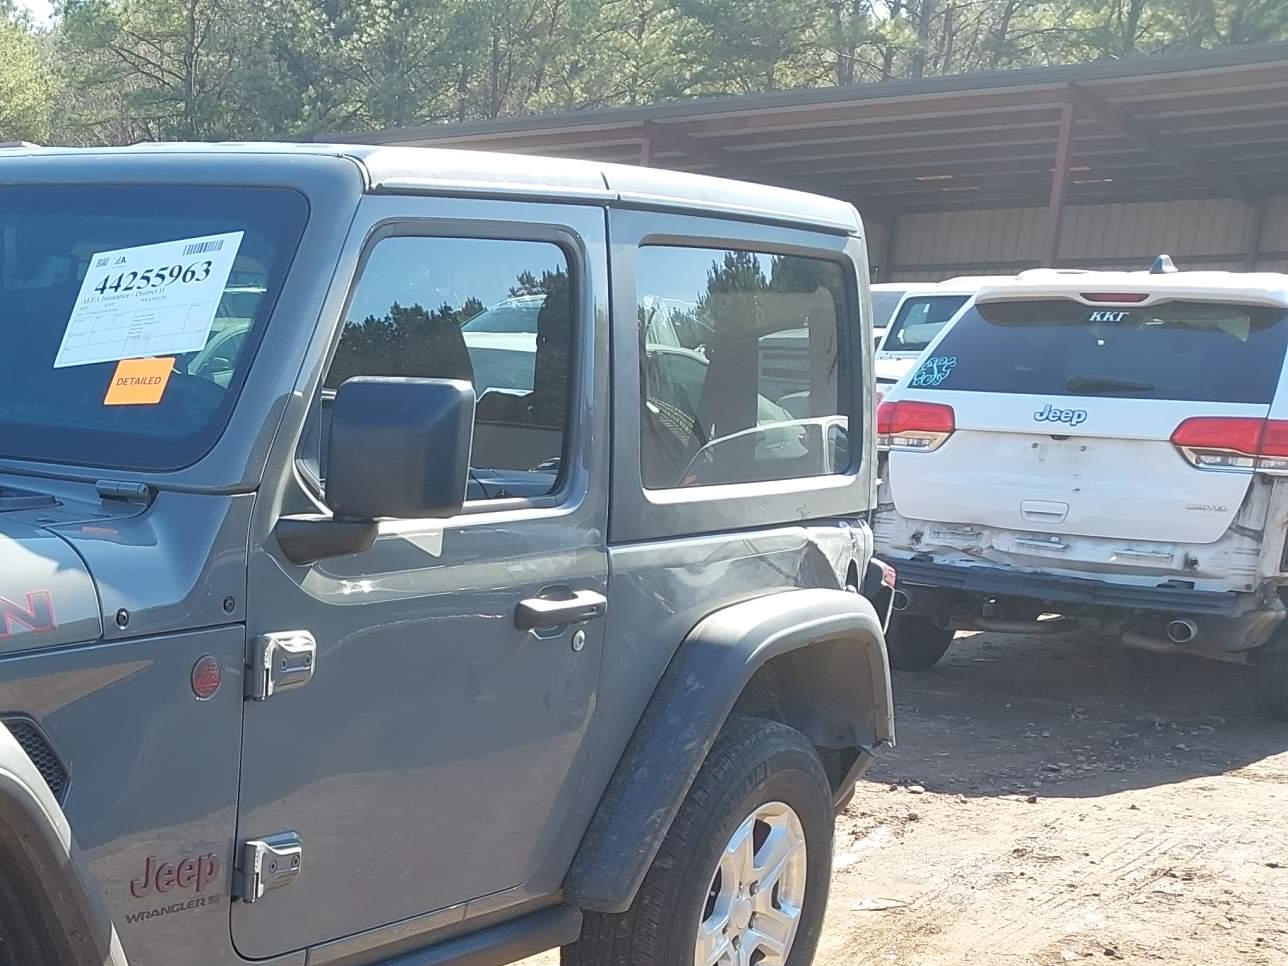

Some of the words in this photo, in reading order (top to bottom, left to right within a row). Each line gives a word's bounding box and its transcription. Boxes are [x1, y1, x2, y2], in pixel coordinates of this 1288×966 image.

[94, 260, 213, 295] 44255963
[116, 376, 162, 386] DETAILED
[1033, 404, 1088, 427] Jeep
[130, 852, 219, 898] Jeep
[125, 898, 206, 924] WRANGLER
